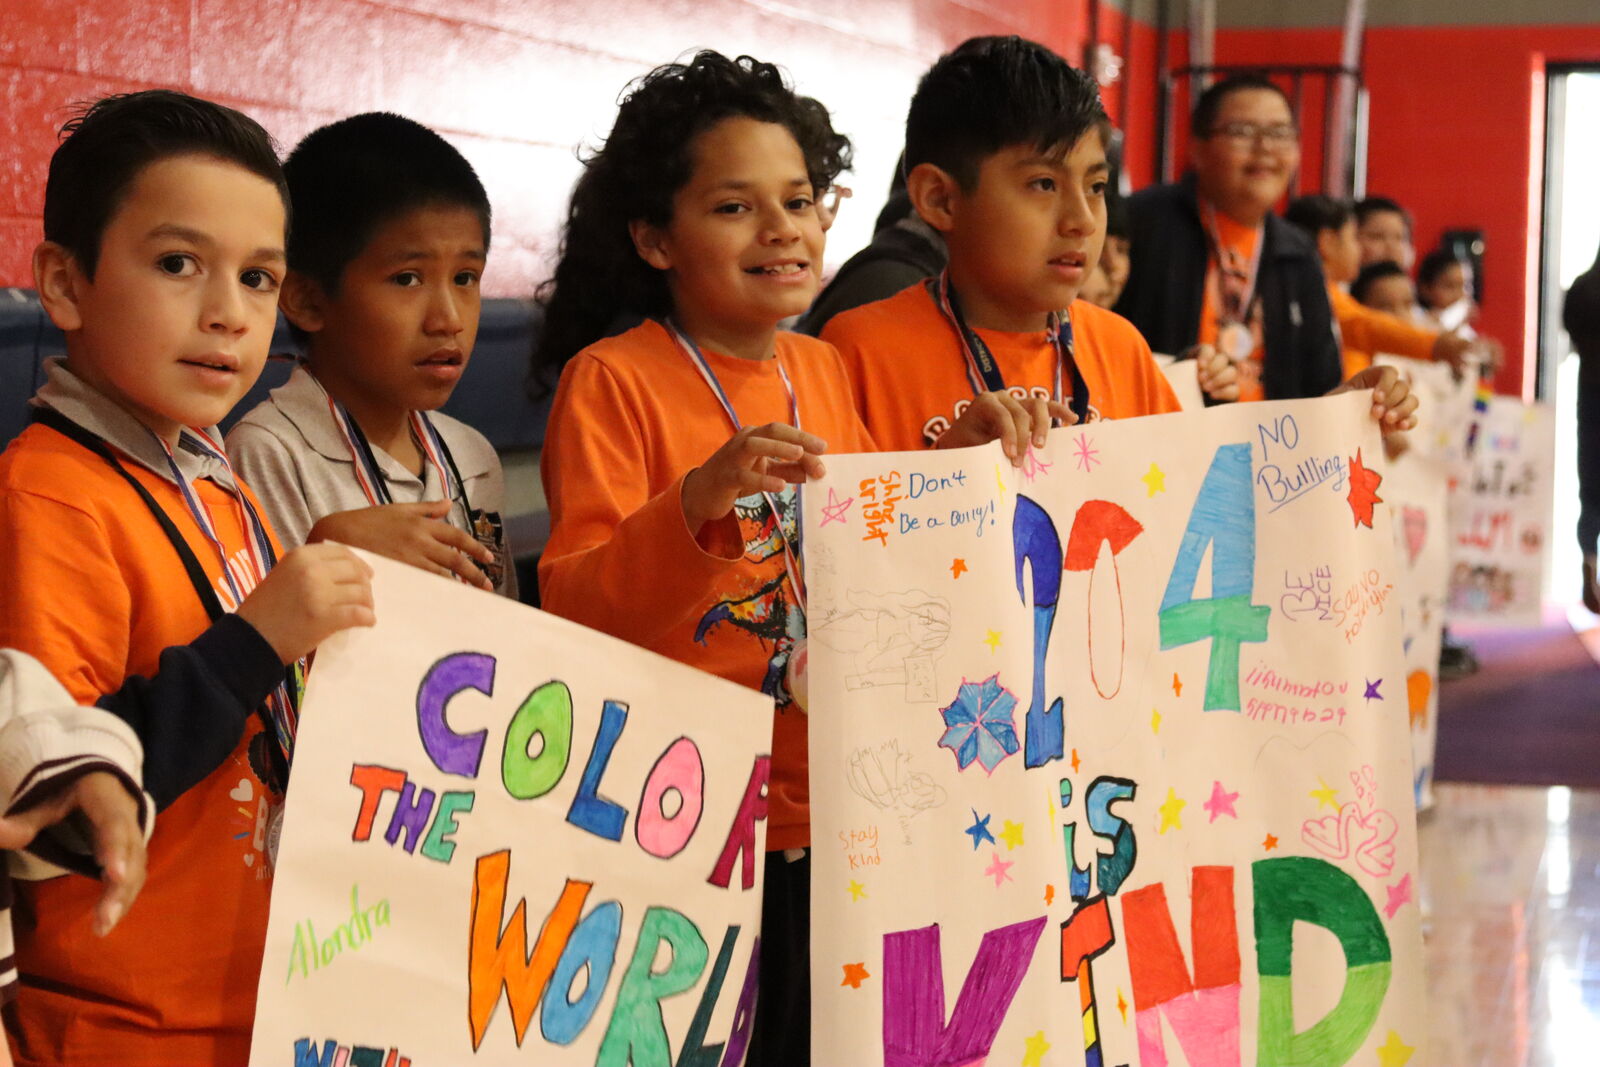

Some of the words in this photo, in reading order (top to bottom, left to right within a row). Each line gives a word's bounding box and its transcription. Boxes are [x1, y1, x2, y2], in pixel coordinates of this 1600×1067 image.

[909, 470, 967, 498] Don't
[1258, 414, 1298, 462] NO
[900, 513, 921, 534] Be
[926, 518, 944, 528] a
[350, 763, 475, 864] THE
[416, 651, 771, 891] COLOR
[1059, 775, 1138, 903] is
[285, 882, 391, 988] Alondra
